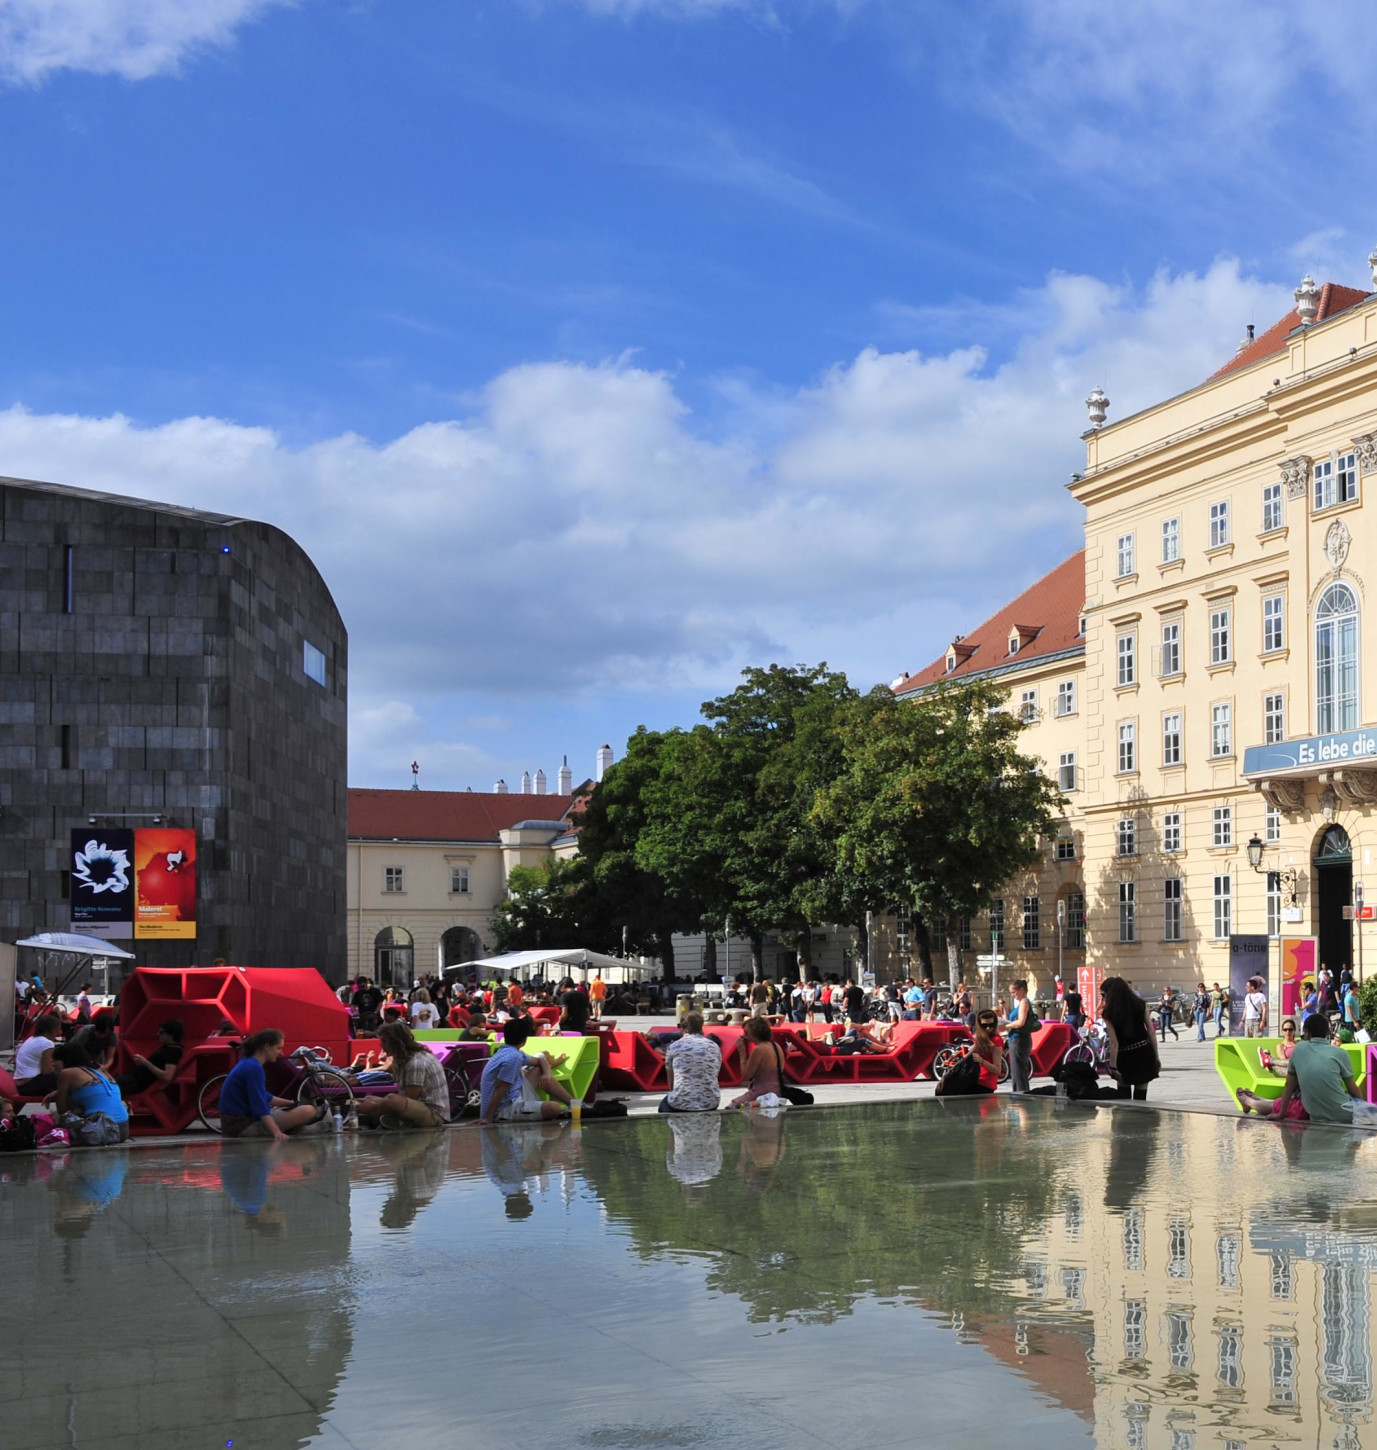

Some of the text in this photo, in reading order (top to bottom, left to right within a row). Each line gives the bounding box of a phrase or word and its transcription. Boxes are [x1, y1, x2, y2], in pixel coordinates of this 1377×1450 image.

[1299, 743, 1315, 763] Es
[1318, 738, 1348, 761] lebe
[1352, 733, 1376, 756] die
[1232, 941, 1267, 953] o-töne
